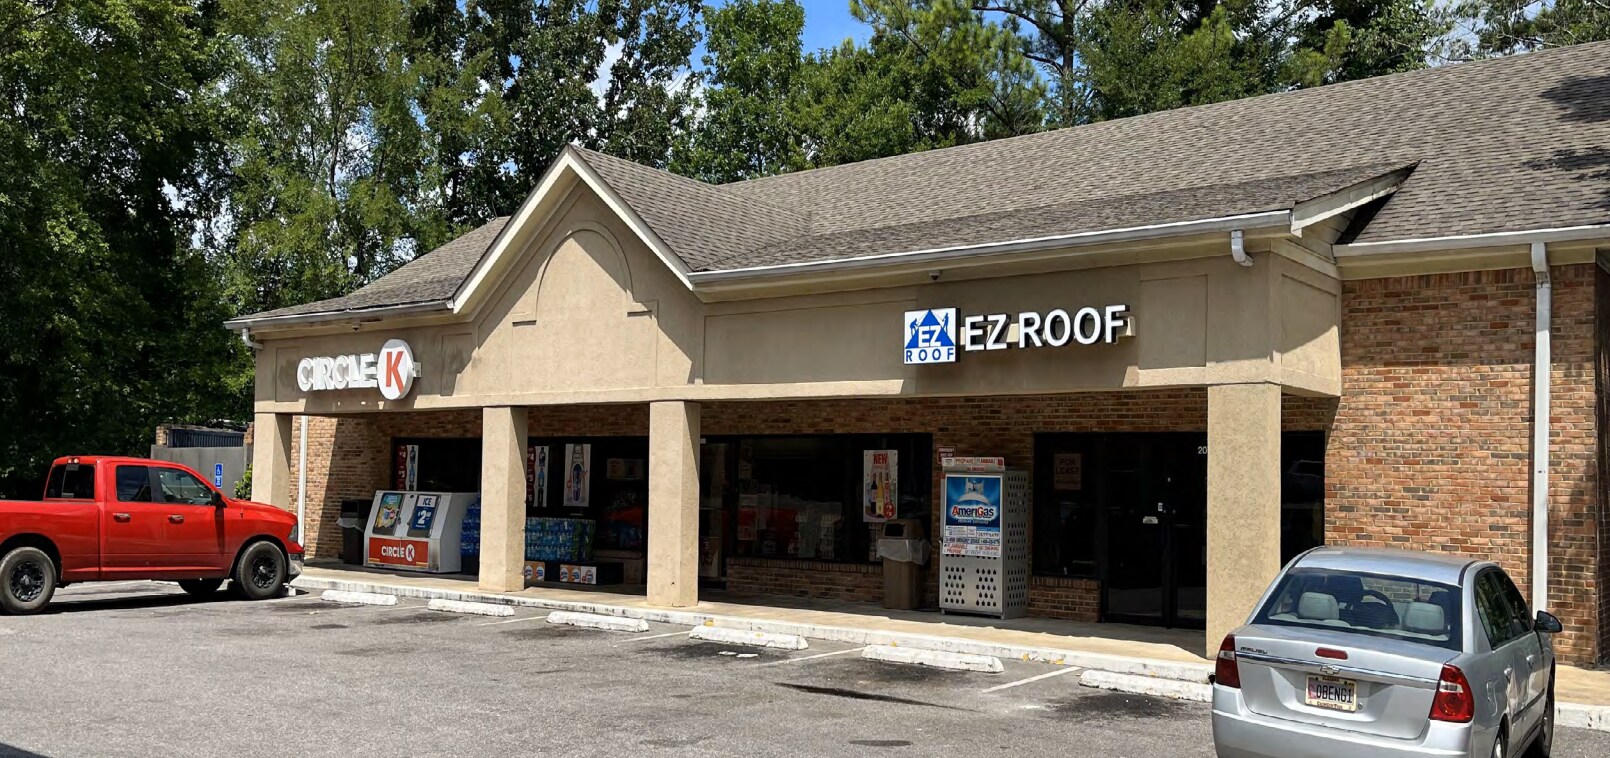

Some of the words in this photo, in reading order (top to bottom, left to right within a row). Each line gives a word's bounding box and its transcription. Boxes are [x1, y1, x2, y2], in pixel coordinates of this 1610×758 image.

[965, 314, 1008, 351] EZ
[1018, 304, 1127, 349] ROOF
[917, 325, 942, 347] EZ
[905, 347, 955, 363] ROOF
[297, 353, 378, 391] CIRCLE
[385, 351, 404, 393] K
[873, 453, 888, 464] NEW
[1060, 458, 1076, 466] FOR
[1056, 467, 1080, 475] LEASE
[423, 498, 432, 506] ICE
[952, 506, 994, 518] AmeriGas
[381, 545, 405, 558] CIRCLE
